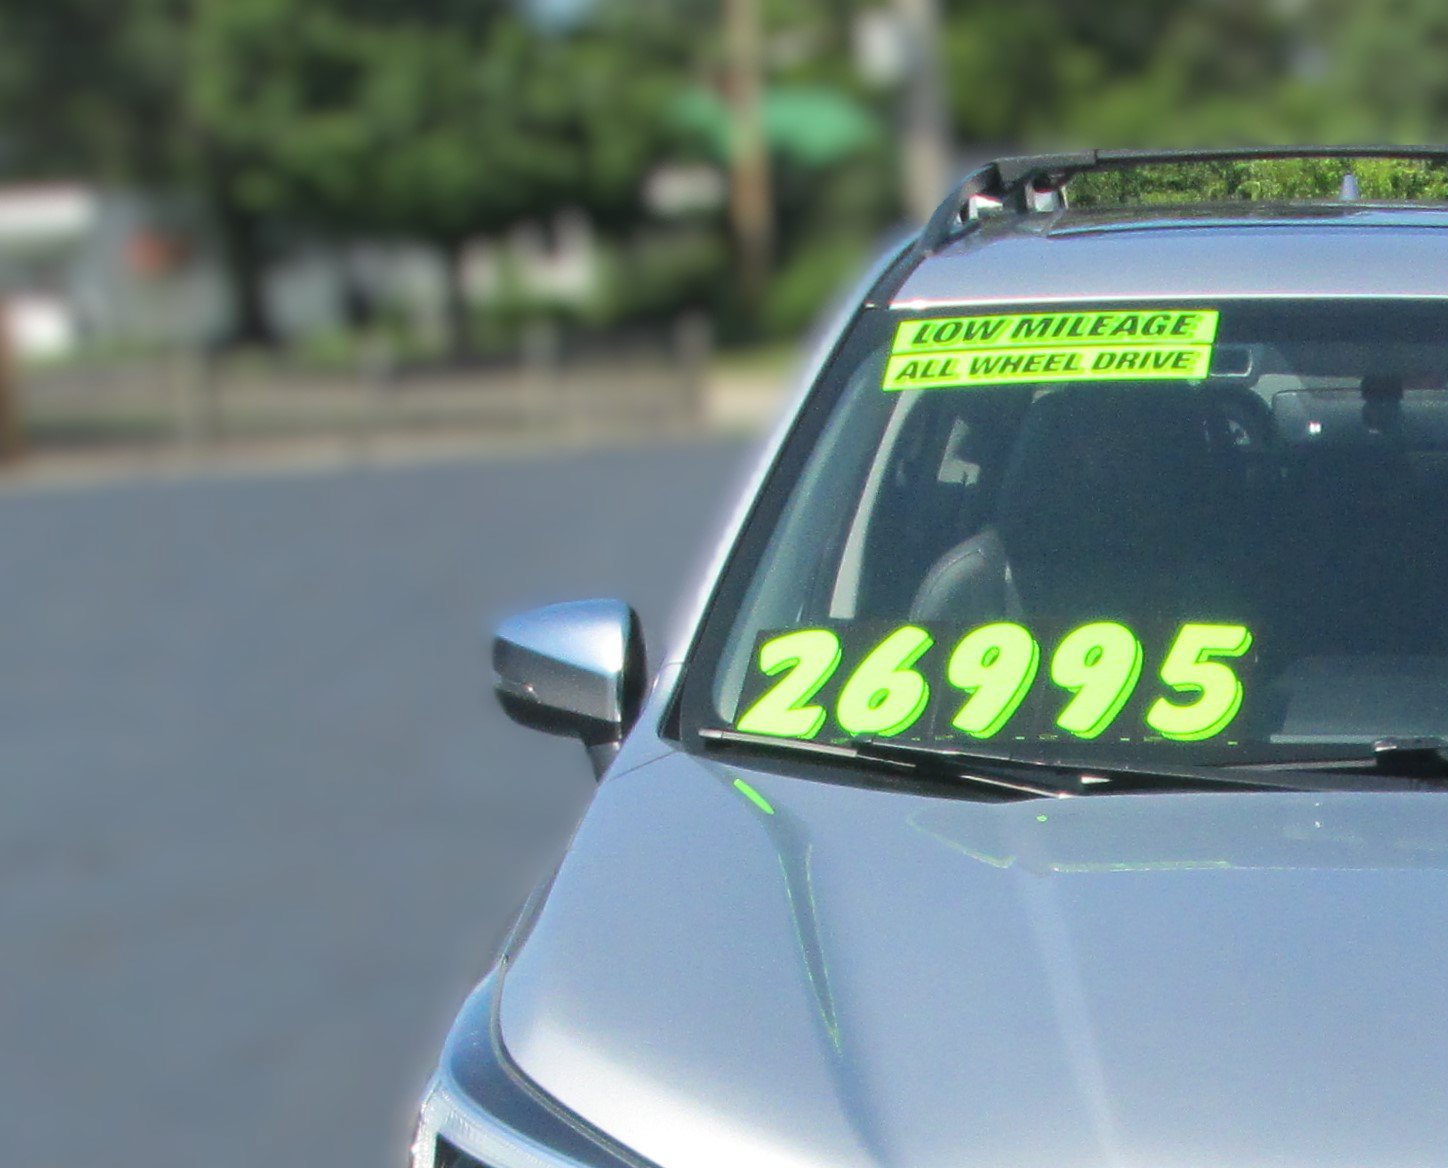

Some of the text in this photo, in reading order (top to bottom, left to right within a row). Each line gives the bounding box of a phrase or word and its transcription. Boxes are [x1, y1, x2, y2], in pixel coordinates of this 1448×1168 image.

[912, 313, 1197, 345] LOW MILEAGE
[895, 350, 1195, 381] ALL WHEEL DRIVE
[736, 621, 1254, 741] 26995
